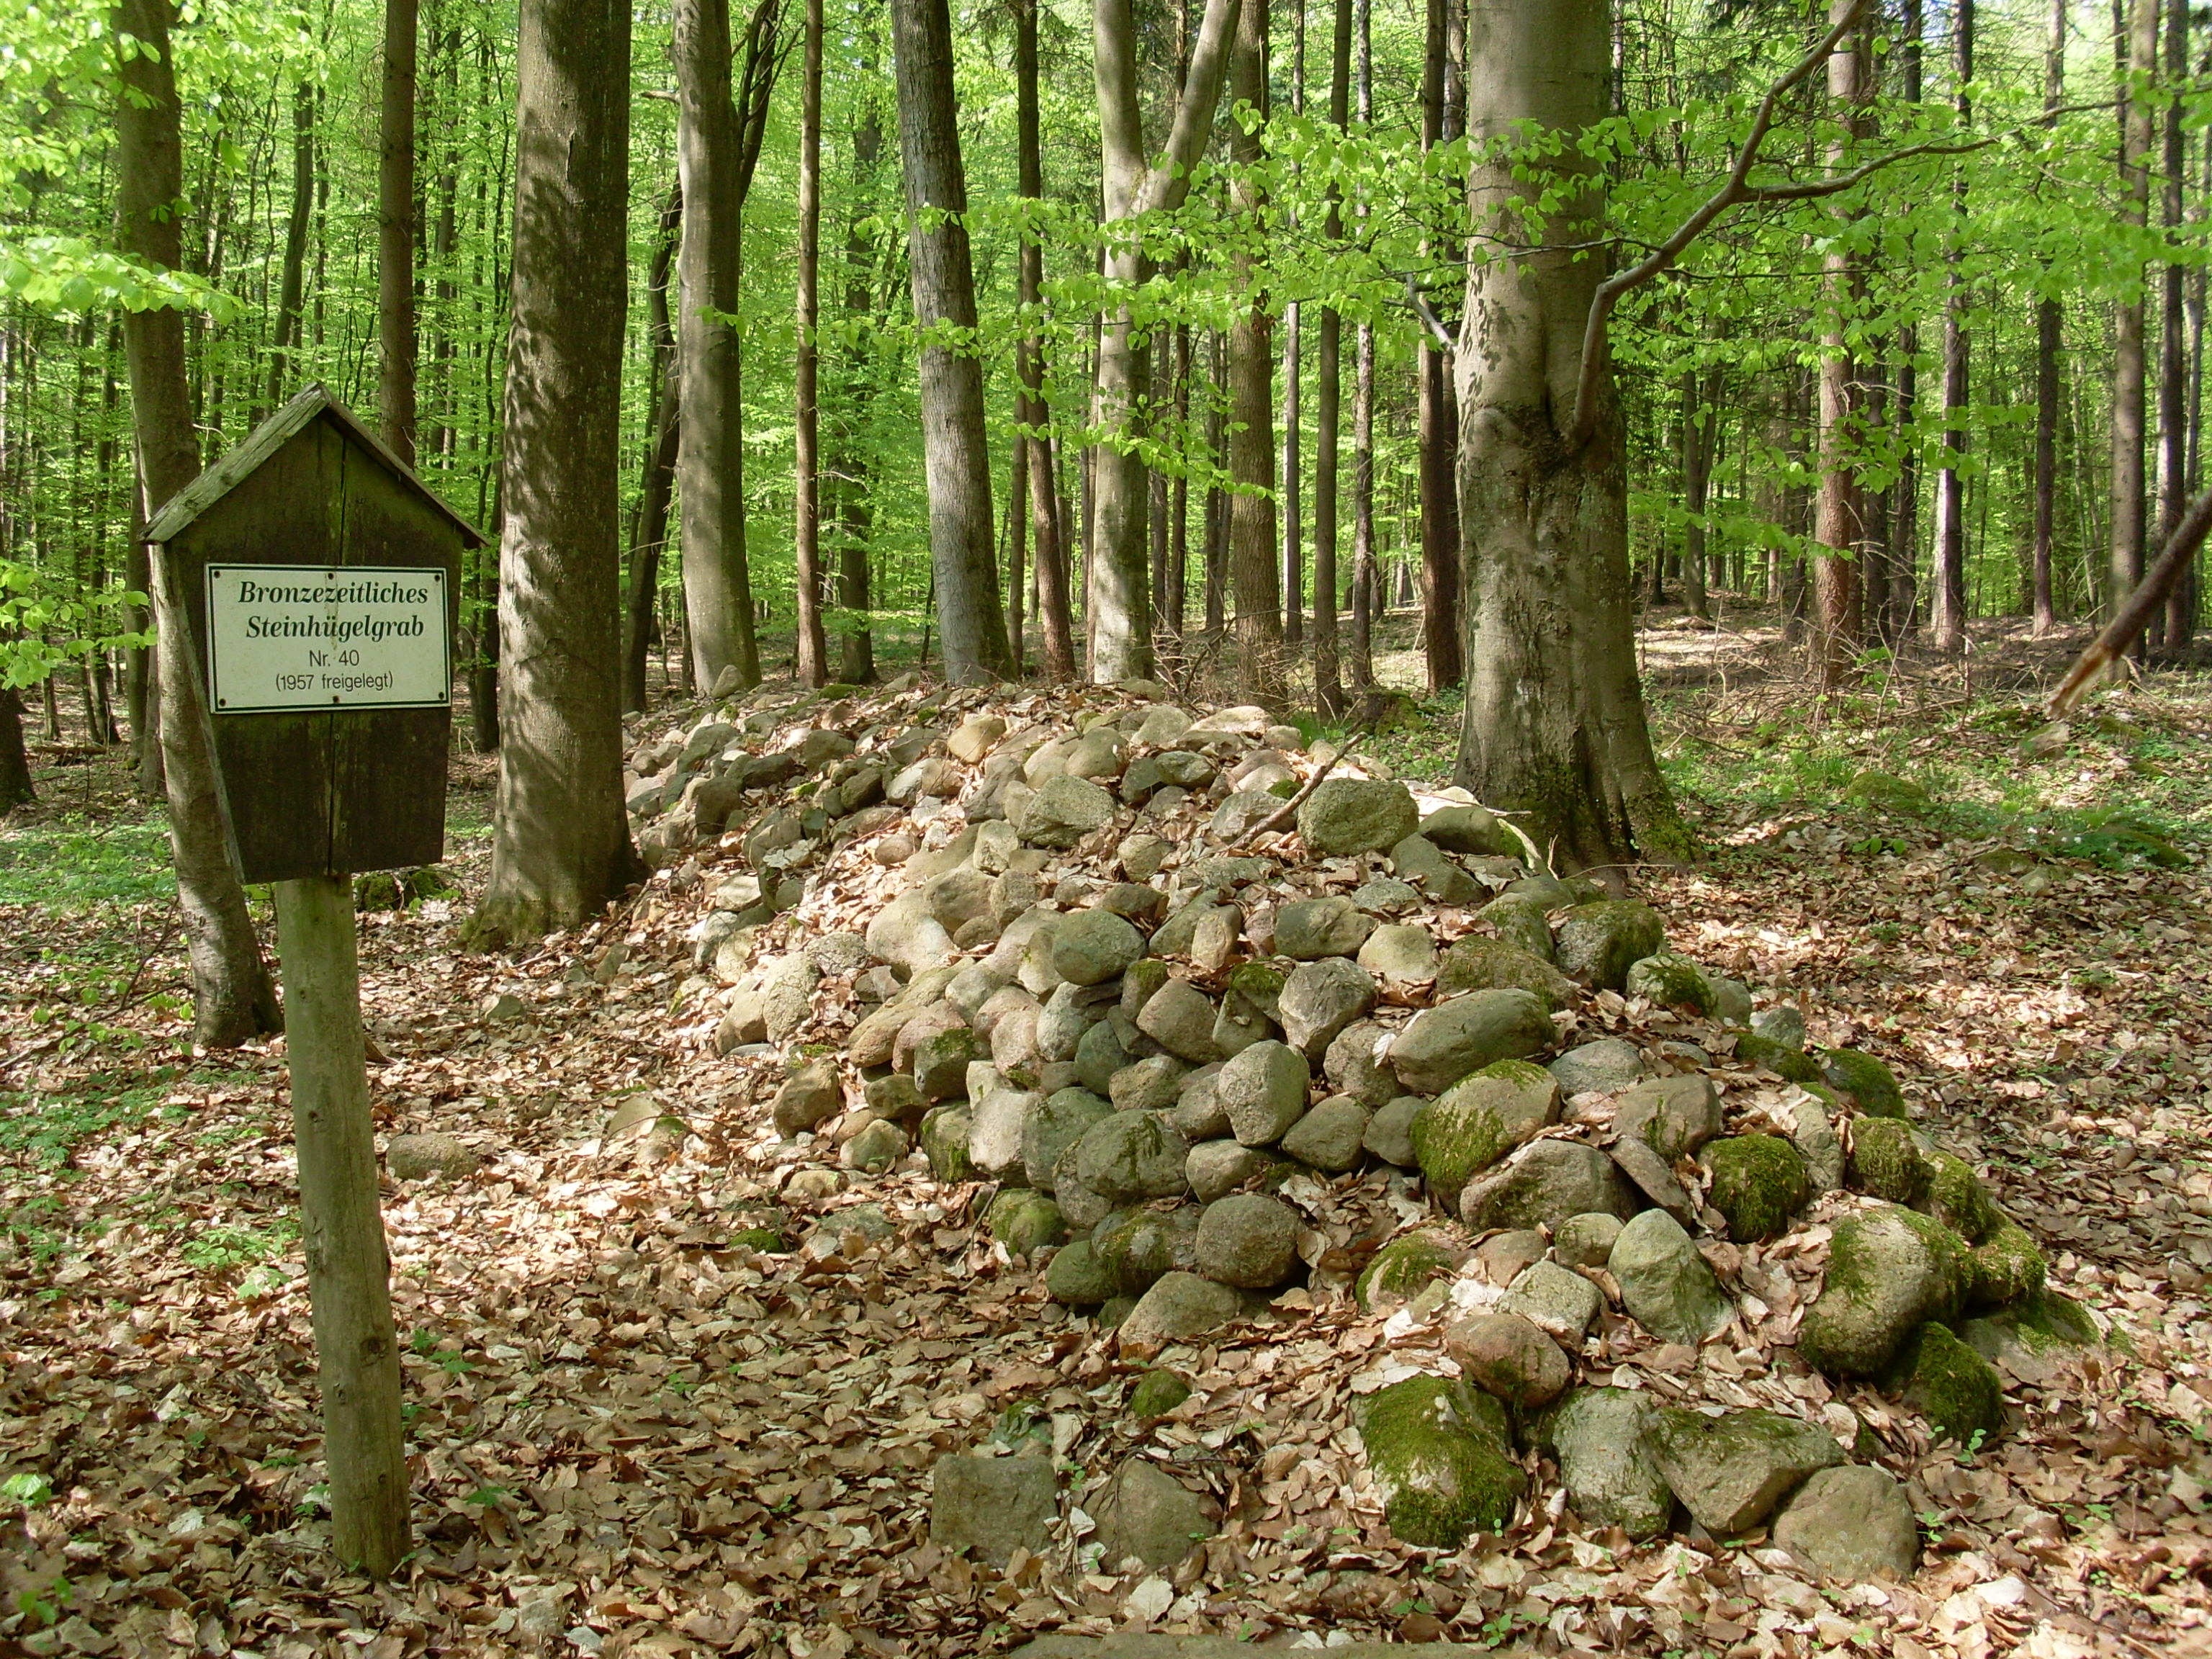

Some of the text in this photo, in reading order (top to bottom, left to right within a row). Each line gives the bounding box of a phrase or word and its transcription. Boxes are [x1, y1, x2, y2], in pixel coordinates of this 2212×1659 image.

[238, 580, 428, 604] Bronzezeitliches
[246, 615, 424, 642] Steinhügelgrab
[309, 649, 359, 667] Nr. 40
[276, 670, 393, 692] (1957 freigelegt)
